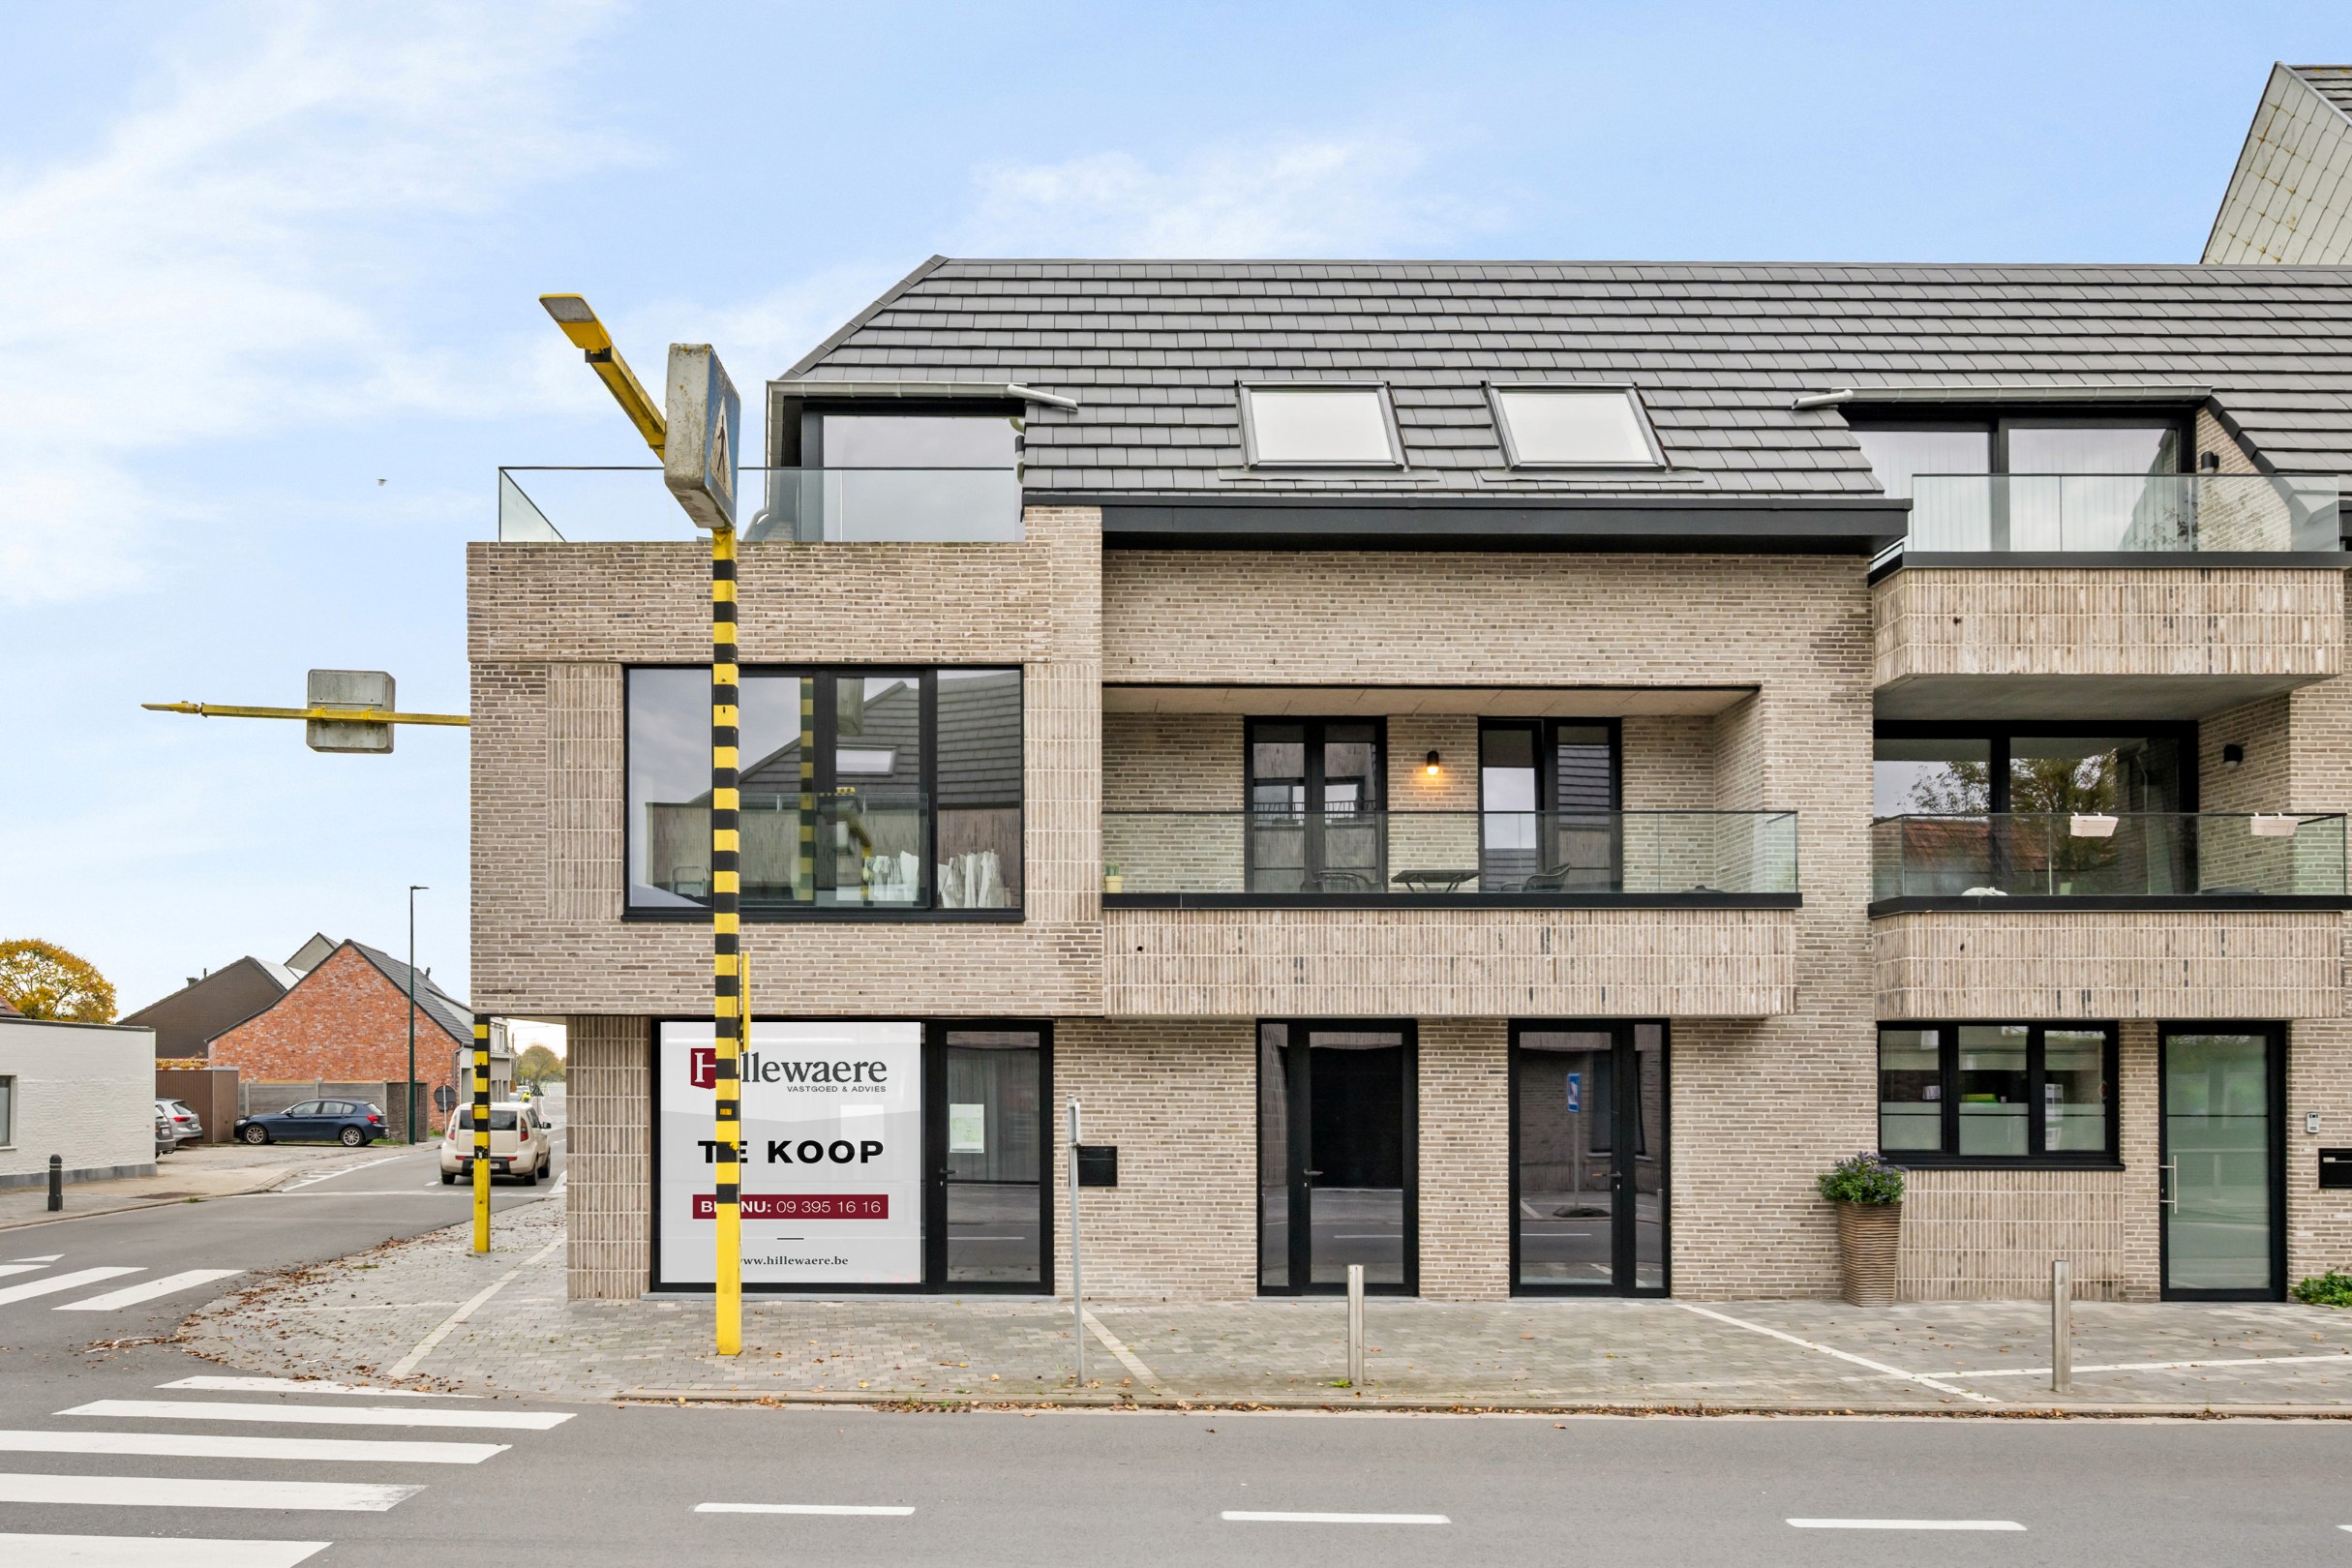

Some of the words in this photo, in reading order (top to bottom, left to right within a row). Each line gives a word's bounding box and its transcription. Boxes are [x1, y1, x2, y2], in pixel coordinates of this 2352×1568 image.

[693, 1051, 888, 1083] Hllewaere
[768, 1139, 884, 1164] KOOP
[740, 1200, 771, 1213] NU:
[776, 1200, 797, 1213] 09
[800, 1200, 831, 1213] 395
[837, 1200, 857, 1213] 16
[862, 1200, 881, 1213] 16
